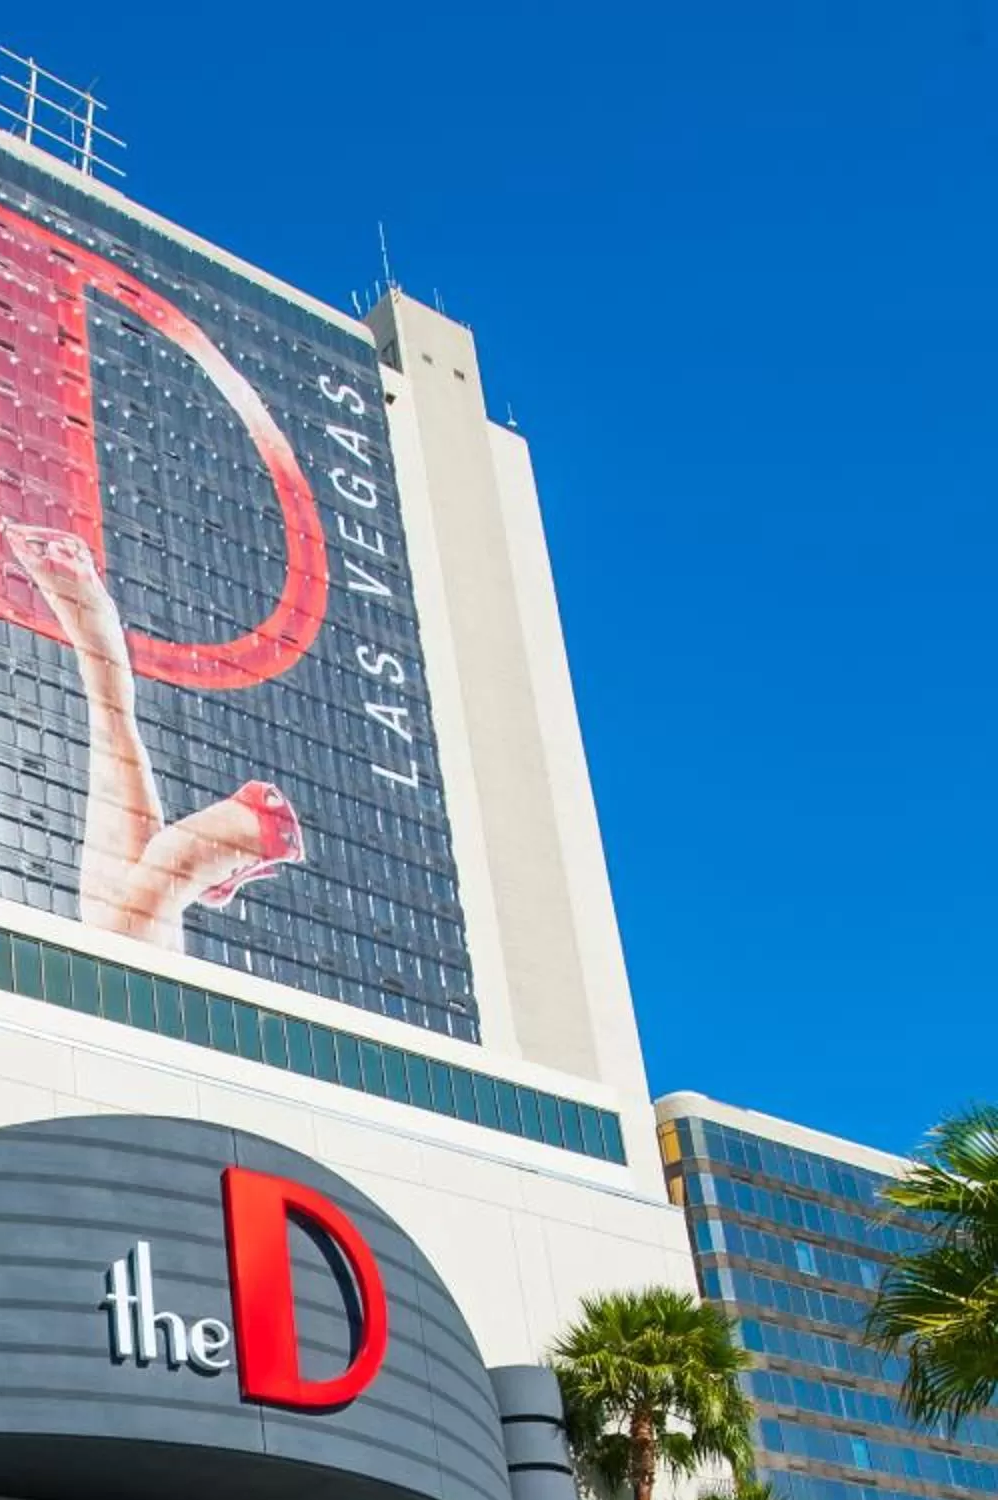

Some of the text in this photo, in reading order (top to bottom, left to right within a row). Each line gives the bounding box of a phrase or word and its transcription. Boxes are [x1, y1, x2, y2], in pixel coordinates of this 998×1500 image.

[318, 374, 420, 788] LAS VEGAS
[100, 1167, 389, 1414] the D
